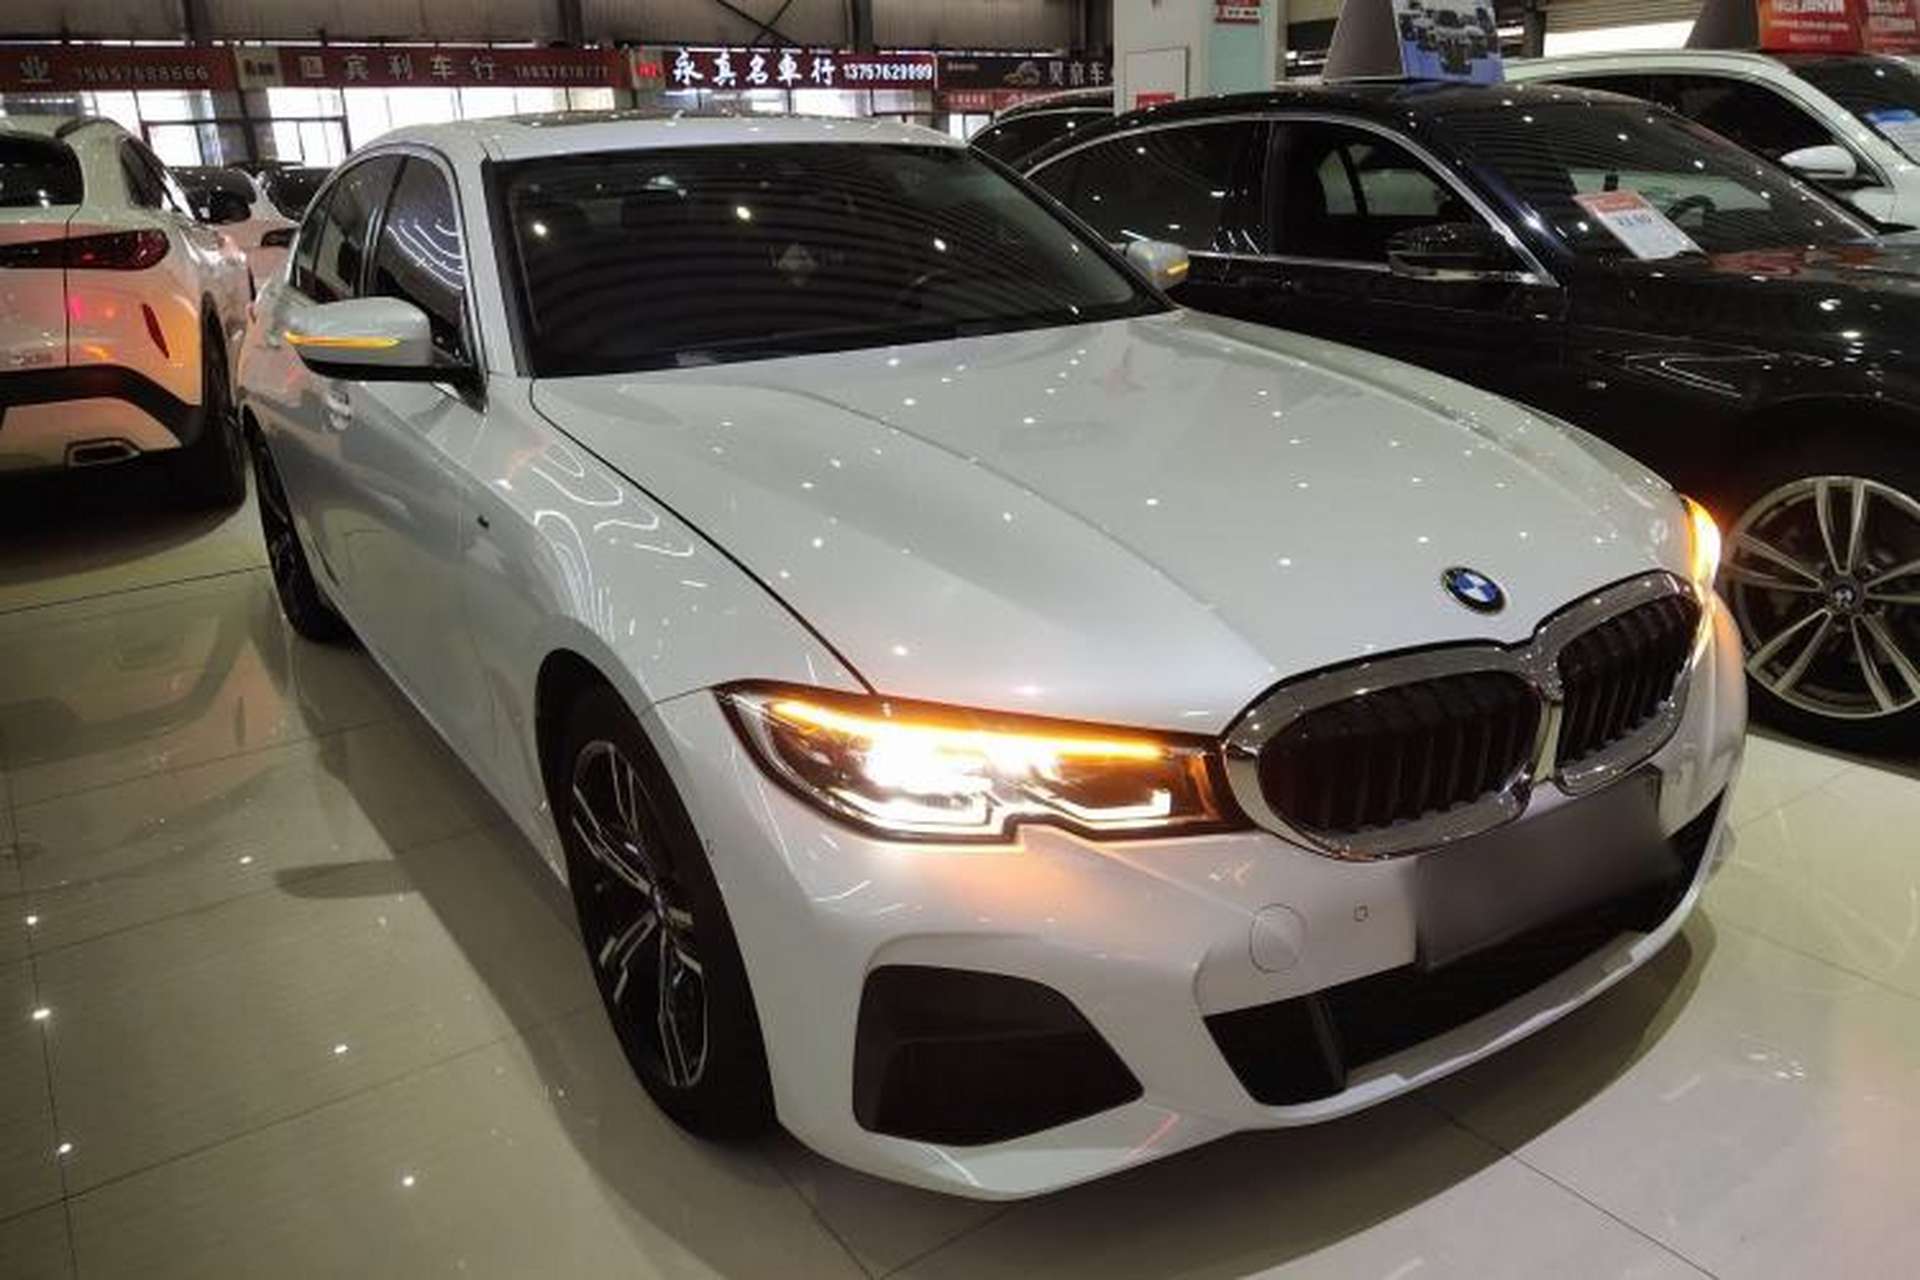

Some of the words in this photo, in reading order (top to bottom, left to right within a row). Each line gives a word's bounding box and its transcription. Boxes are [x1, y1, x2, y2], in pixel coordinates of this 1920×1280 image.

[673, 51, 836, 86] 永真名車行
